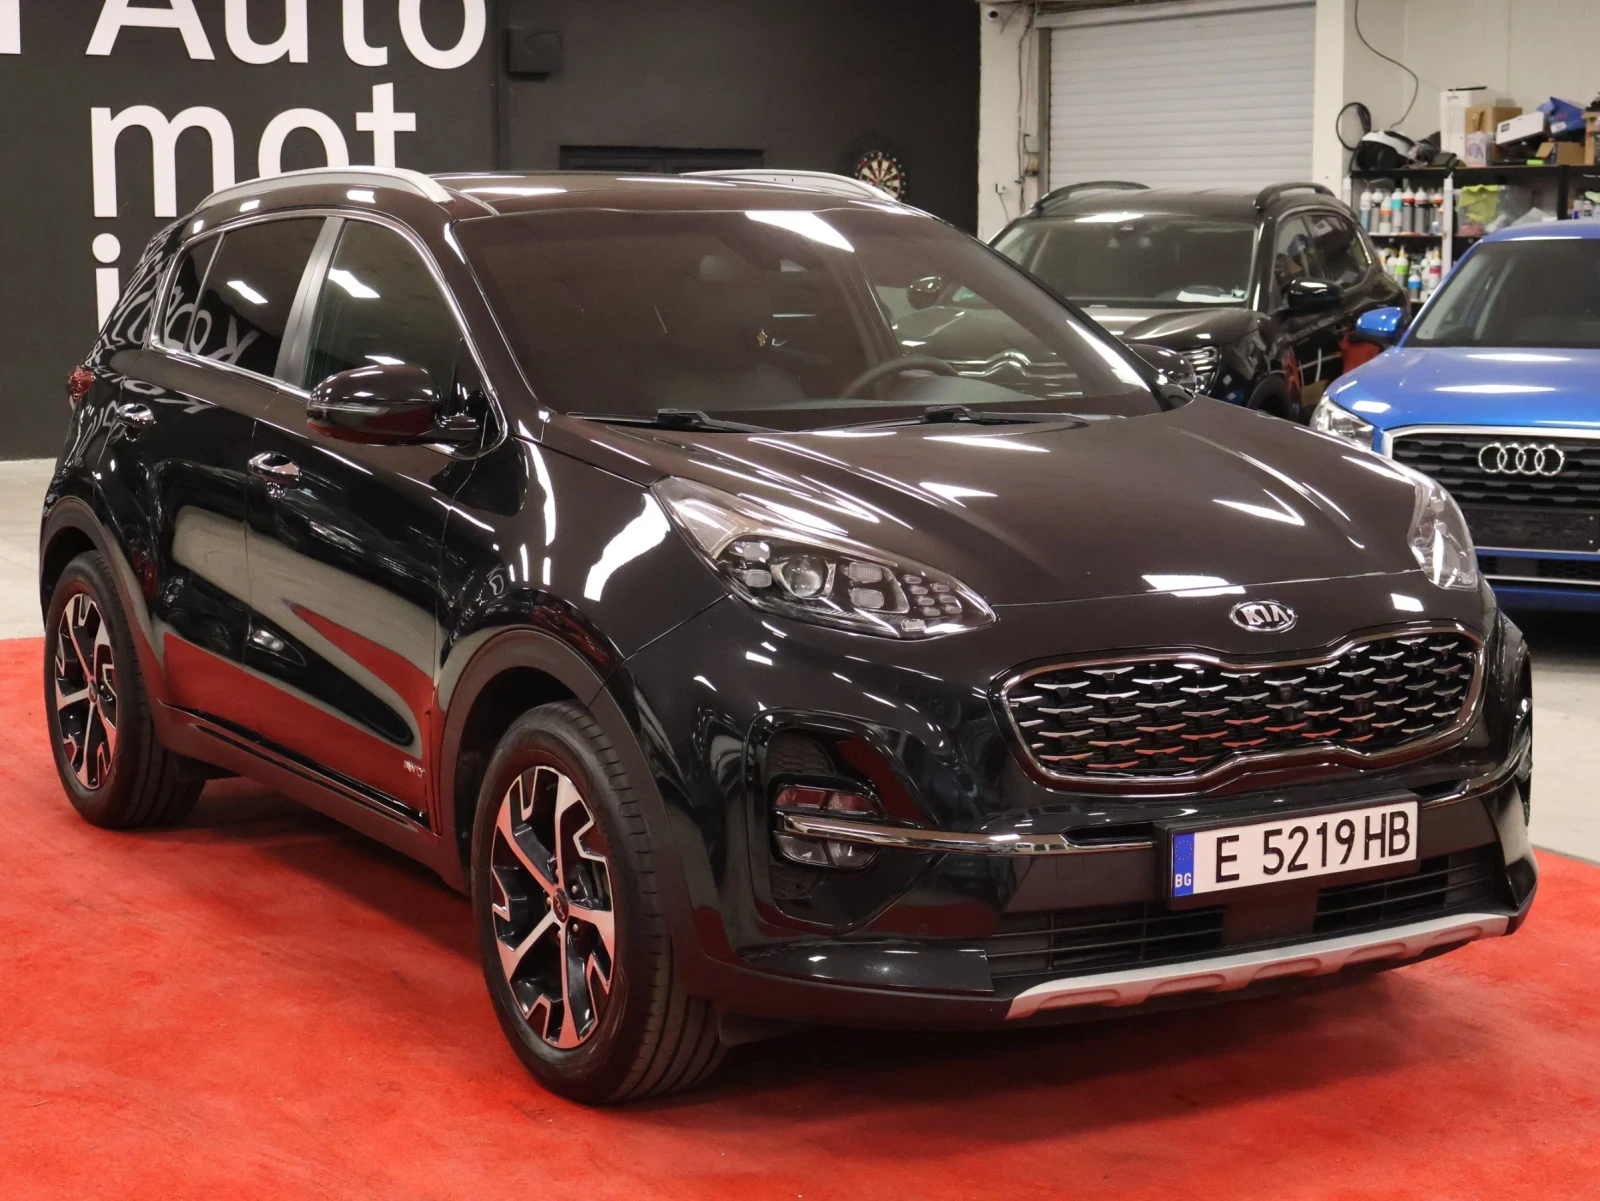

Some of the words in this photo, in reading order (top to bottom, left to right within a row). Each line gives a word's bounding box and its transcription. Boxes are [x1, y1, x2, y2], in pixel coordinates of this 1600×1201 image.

[1239, 604, 1290, 626] KIA
[1215, 834, 1240, 883] E
[1174, 872, 1193, 888] BG
